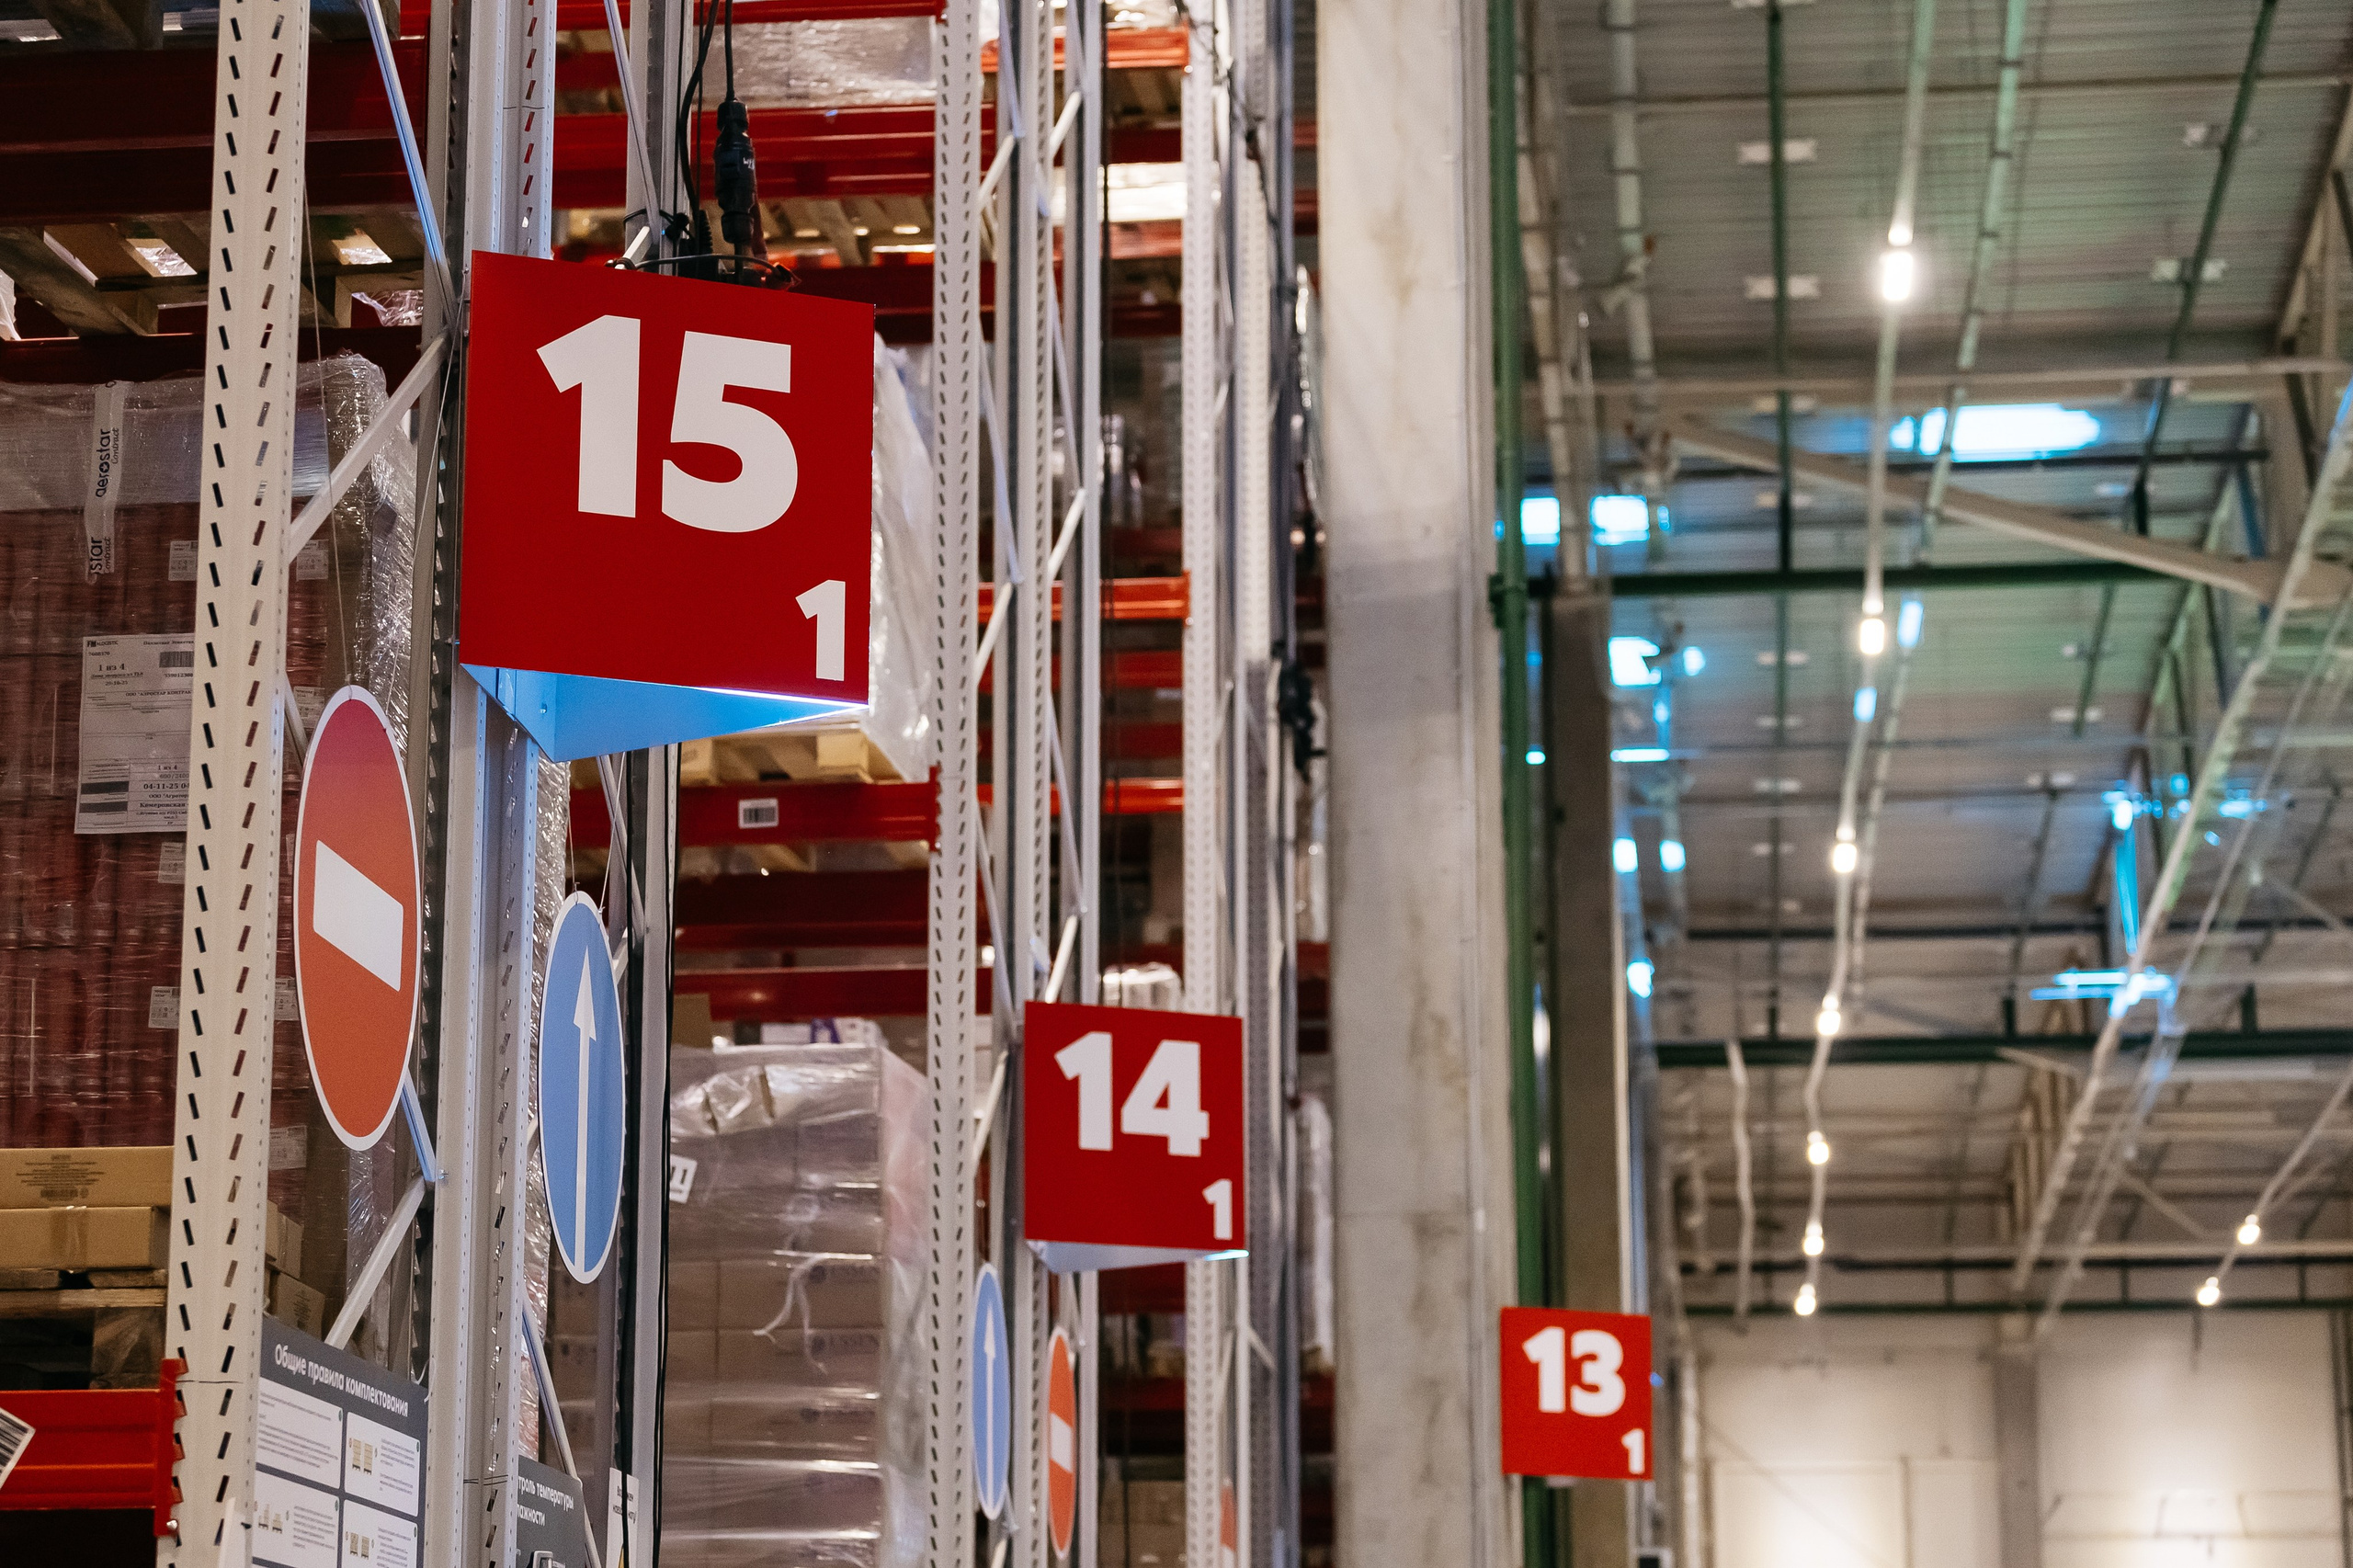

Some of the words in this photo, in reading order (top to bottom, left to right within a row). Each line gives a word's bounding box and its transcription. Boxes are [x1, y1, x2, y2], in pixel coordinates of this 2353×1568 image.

[111, 426, 119, 464] Contract
[536, 314, 798, 532] 15
[96, 428, 111, 497] aerostar
[89, 537, 103, 573] star
[795, 579, 846, 681] 1
[119, 663, 126, 671] 4
[1054, 1030, 1210, 1157] 14
[1202, 1178, 1233, 1241] 1
[275, 1344, 306, 1376] Общие
[308, 1360, 345, 1391] правила
[345, 1376, 409, 1418] комплектования
[1522, 1326, 1626, 1417] 13
[1621, 1427, 1645, 1474] 1
[536, 1483, 574, 1512] температуры
